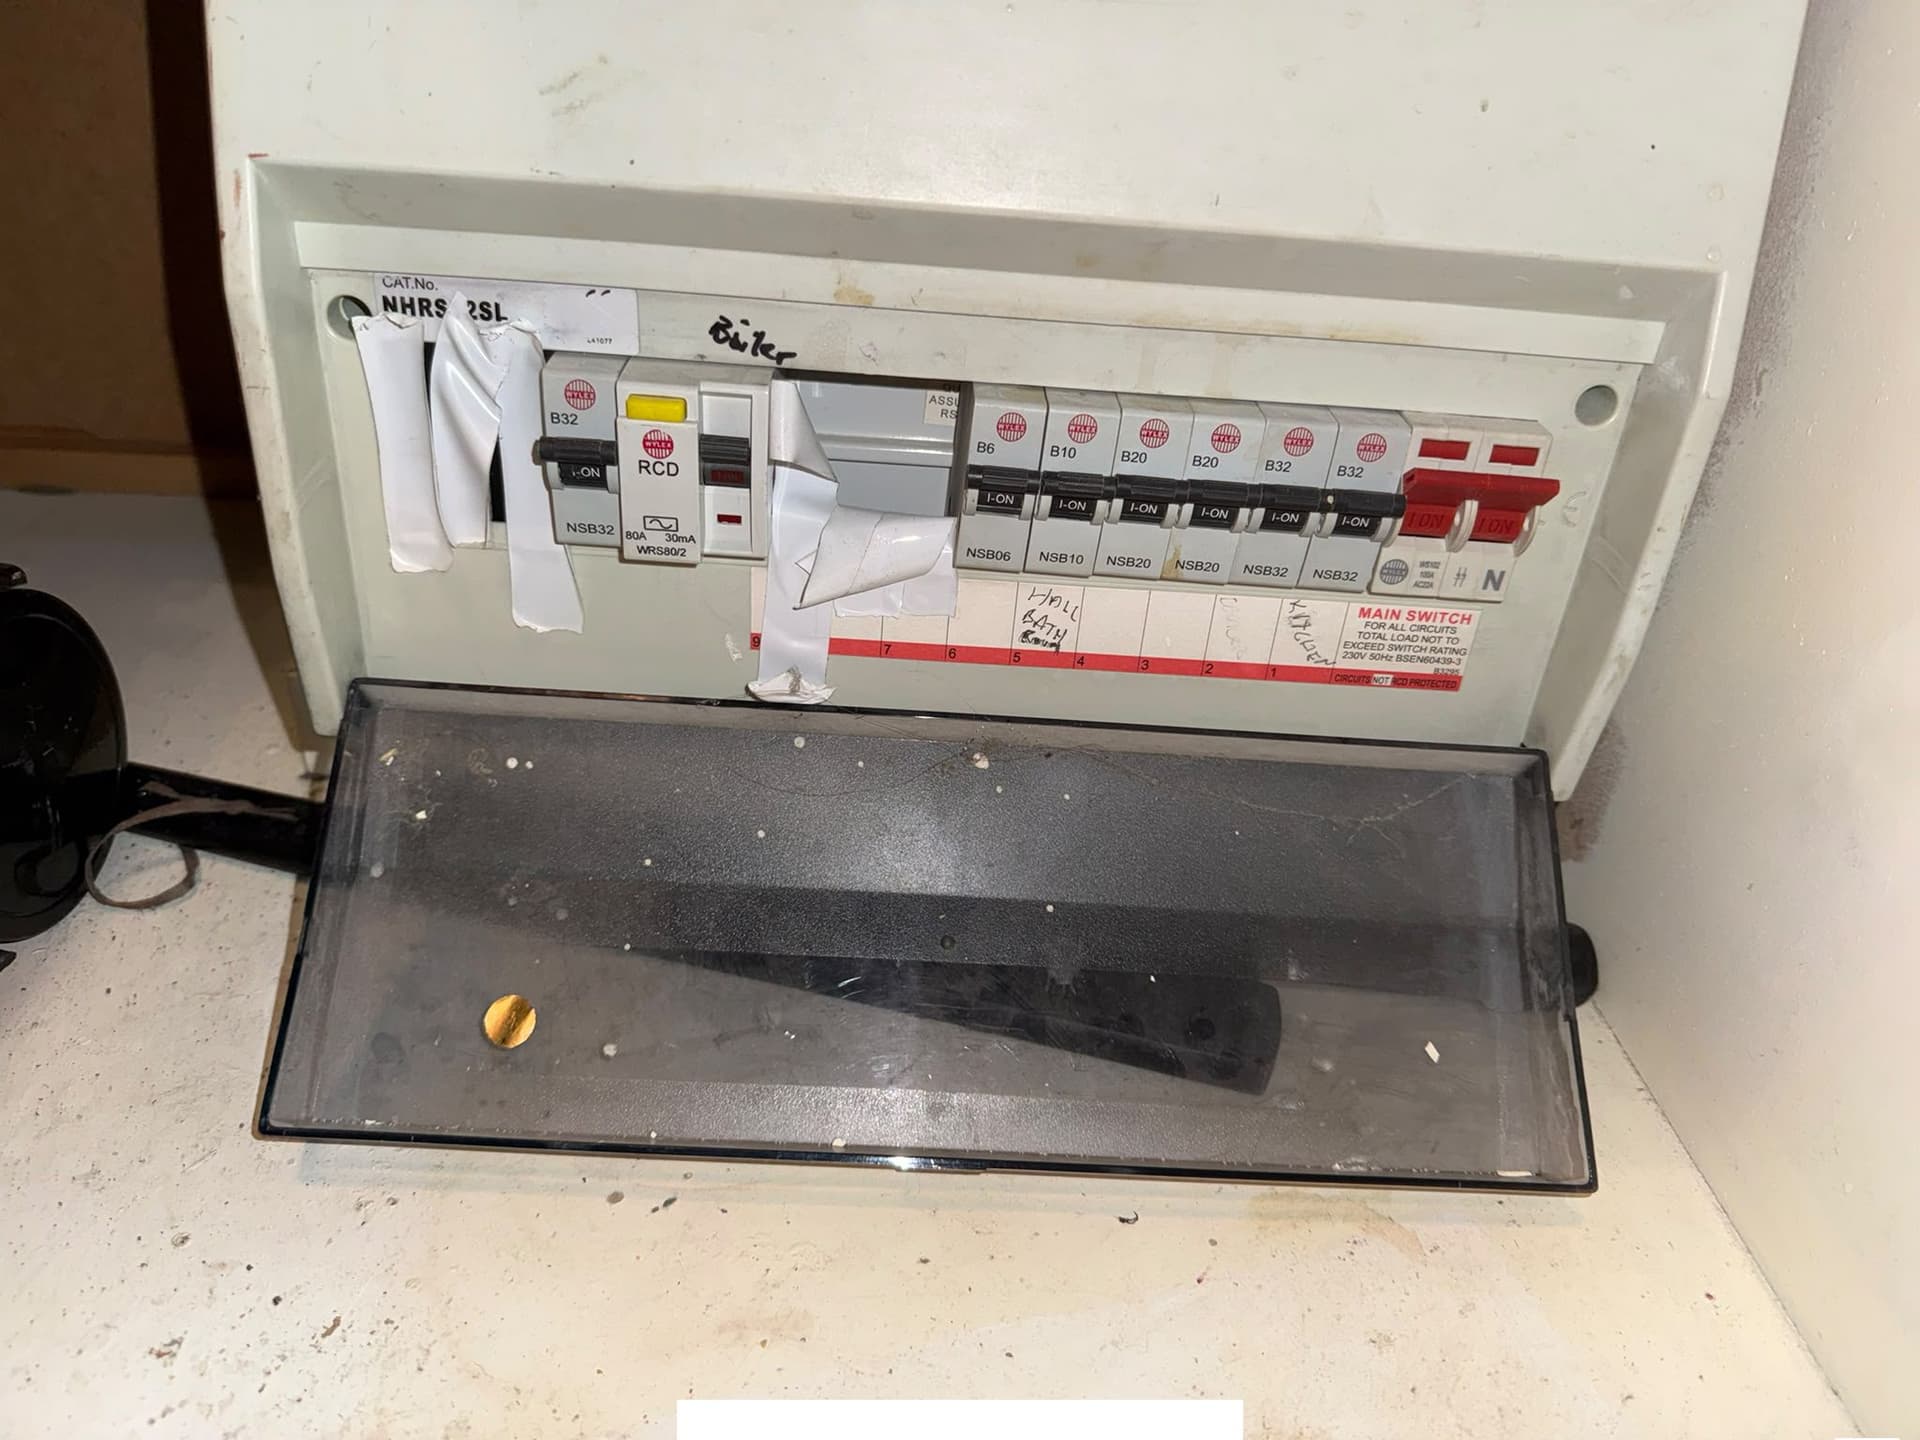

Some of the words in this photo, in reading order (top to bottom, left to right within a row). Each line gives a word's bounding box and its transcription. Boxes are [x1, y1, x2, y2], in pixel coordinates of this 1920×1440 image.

[382, 295, 508, 322] NHRS2SL
[551, 412, 579, 425] B32
[977, 441, 995, 454] B6
[1050, 445, 1077, 459] B10
[1121, 450, 1148, 464] B20
[1192, 455, 1219, 468] B20
[638, 459, 680, 477] RCD
[1265, 459, 1292, 473] B32
[1337, 465, 1364, 478] B32
[566, 522, 615, 536] NSB32
[625, 531, 648, 541] 80A
[665, 534, 697, 544] 30mA
[636, 545, 687, 557] WRS80/2
[966, 548, 1012, 561] NSB06
[1039, 551, 1084, 565] NSB10
[1106, 555, 1151, 568] NSB20
[1175, 560, 1220, 573] NSB20
[1243, 564, 1289, 578] NSB32
[1313, 568, 1359, 582] NSB32
[1482, 569, 1506, 591] N
[1358, 607, 1402, 621] MAIN
[1405, 610, 1473, 625] SWITCH
[1363, 621, 1387, 631] FOR
[1388, 623, 1407, 632] ALL
[1409, 624, 1457, 634] CIRCUITS
[752, 636, 761, 648] 9
[1357, 631, 1388, 641] TOTAL
[1390, 633, 1419, 643] LOAD
[1420, 635, 1443, 645] NOT
[1445, 637, 1460, 646] TO
[884, 643, 892, 655] 7
[948, 648, 957, 659] 6
[1342, 641, 1385, 651] EXCEED
[1387, 643, 1428, 654] SWITCH
[1429, 646, 1468, 657] RATING
[1013, 651, 1021, 663] 5
[1076, 655, 1085, 667] 4
[1341, 651, 1367, 661] 230V
[1368, 653, 1394, 662] 50Hz
[1140, 659, 1149, 671] 3
[1204, 663, 1214, 674] 2
[1271, 667, 1277, 678] 1
[1334, 673, 1372, 684] CIRCUITS
[1373, 675, 1391, 685] NOT
[1408, 678, 1458, 690] PROTECTED
